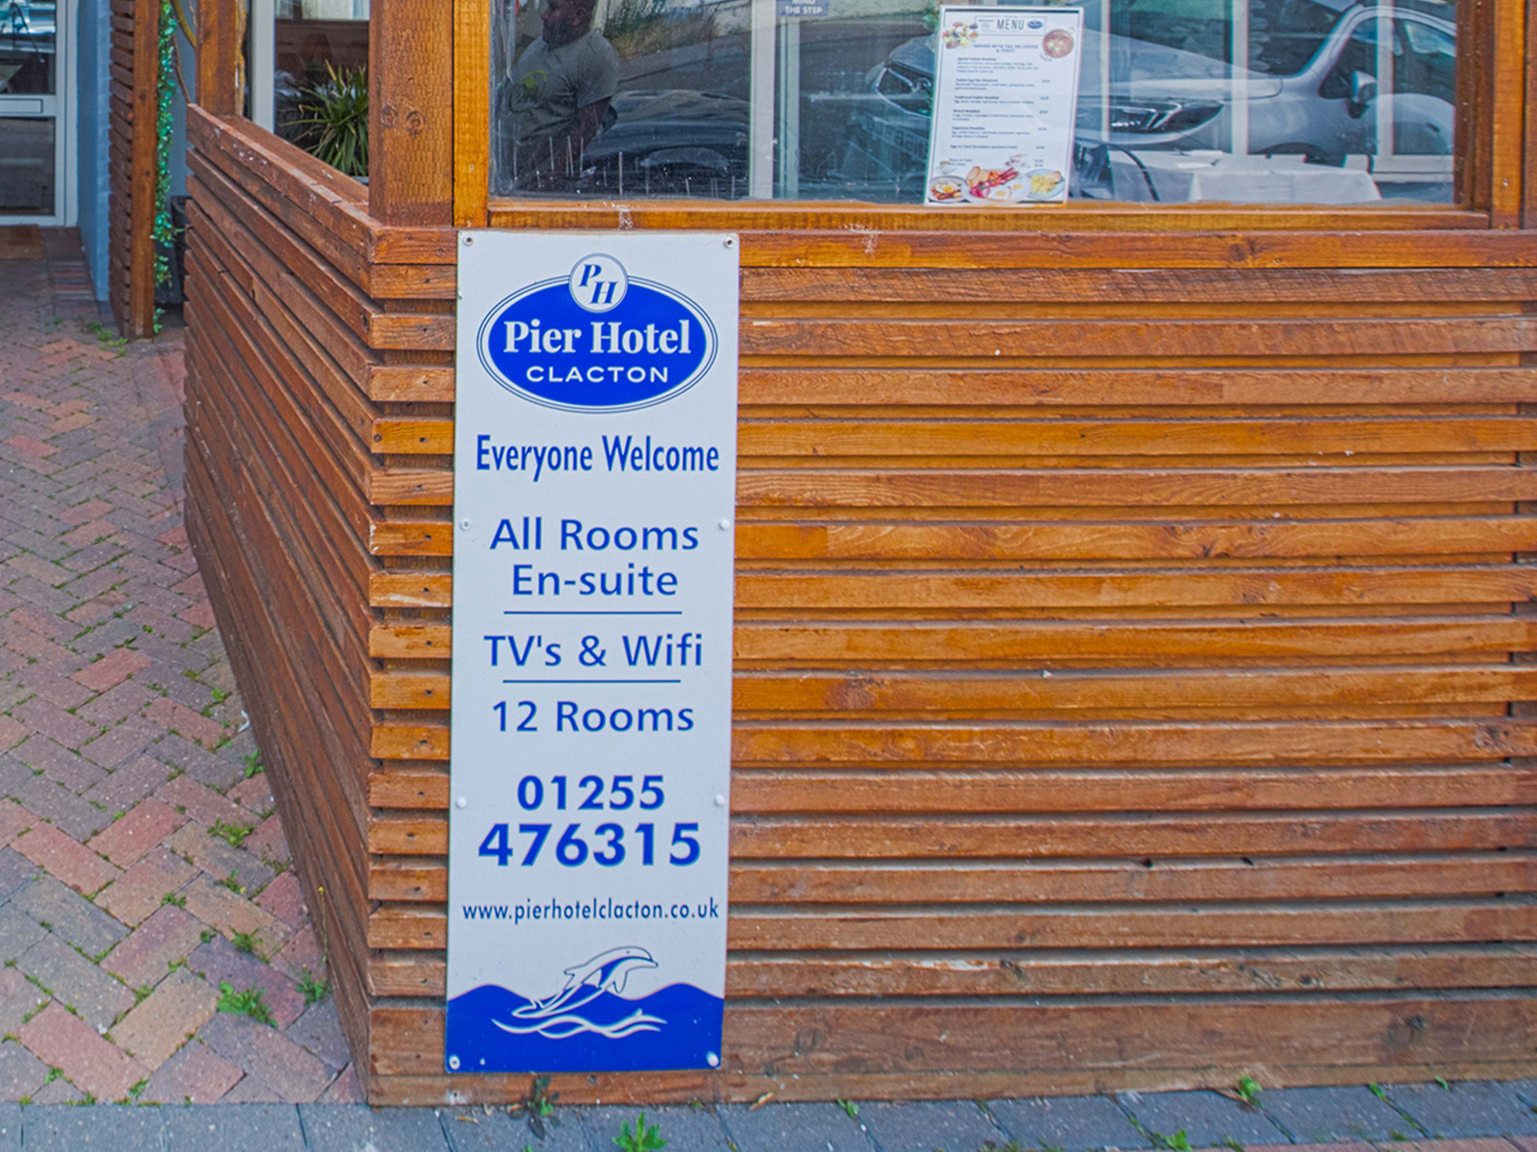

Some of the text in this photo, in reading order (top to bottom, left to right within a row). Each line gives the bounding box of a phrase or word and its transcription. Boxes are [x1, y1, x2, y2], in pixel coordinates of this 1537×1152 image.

[785, 6, 823, 14] THE STEP
[997, 19, 1025, 30] MENU
[503, 318, 691, 354] Pier Hotel
[526, 366, 669, 384] CLACTON
[476, 434, 720, 482] Everyone Welcome
[489, 516, 699, 551] All Rooms
[512, 563, 679, 596] En-suite
[483, 633, 703, 667] TV's & Wifi
[492, 700, 695, 733] 12 Rooms
[517, 775, 665, 811] 01255
[477, 822, 702, 867] 476315
[462, 897, 720, 925] www.pierhotelclacton.co.uk
